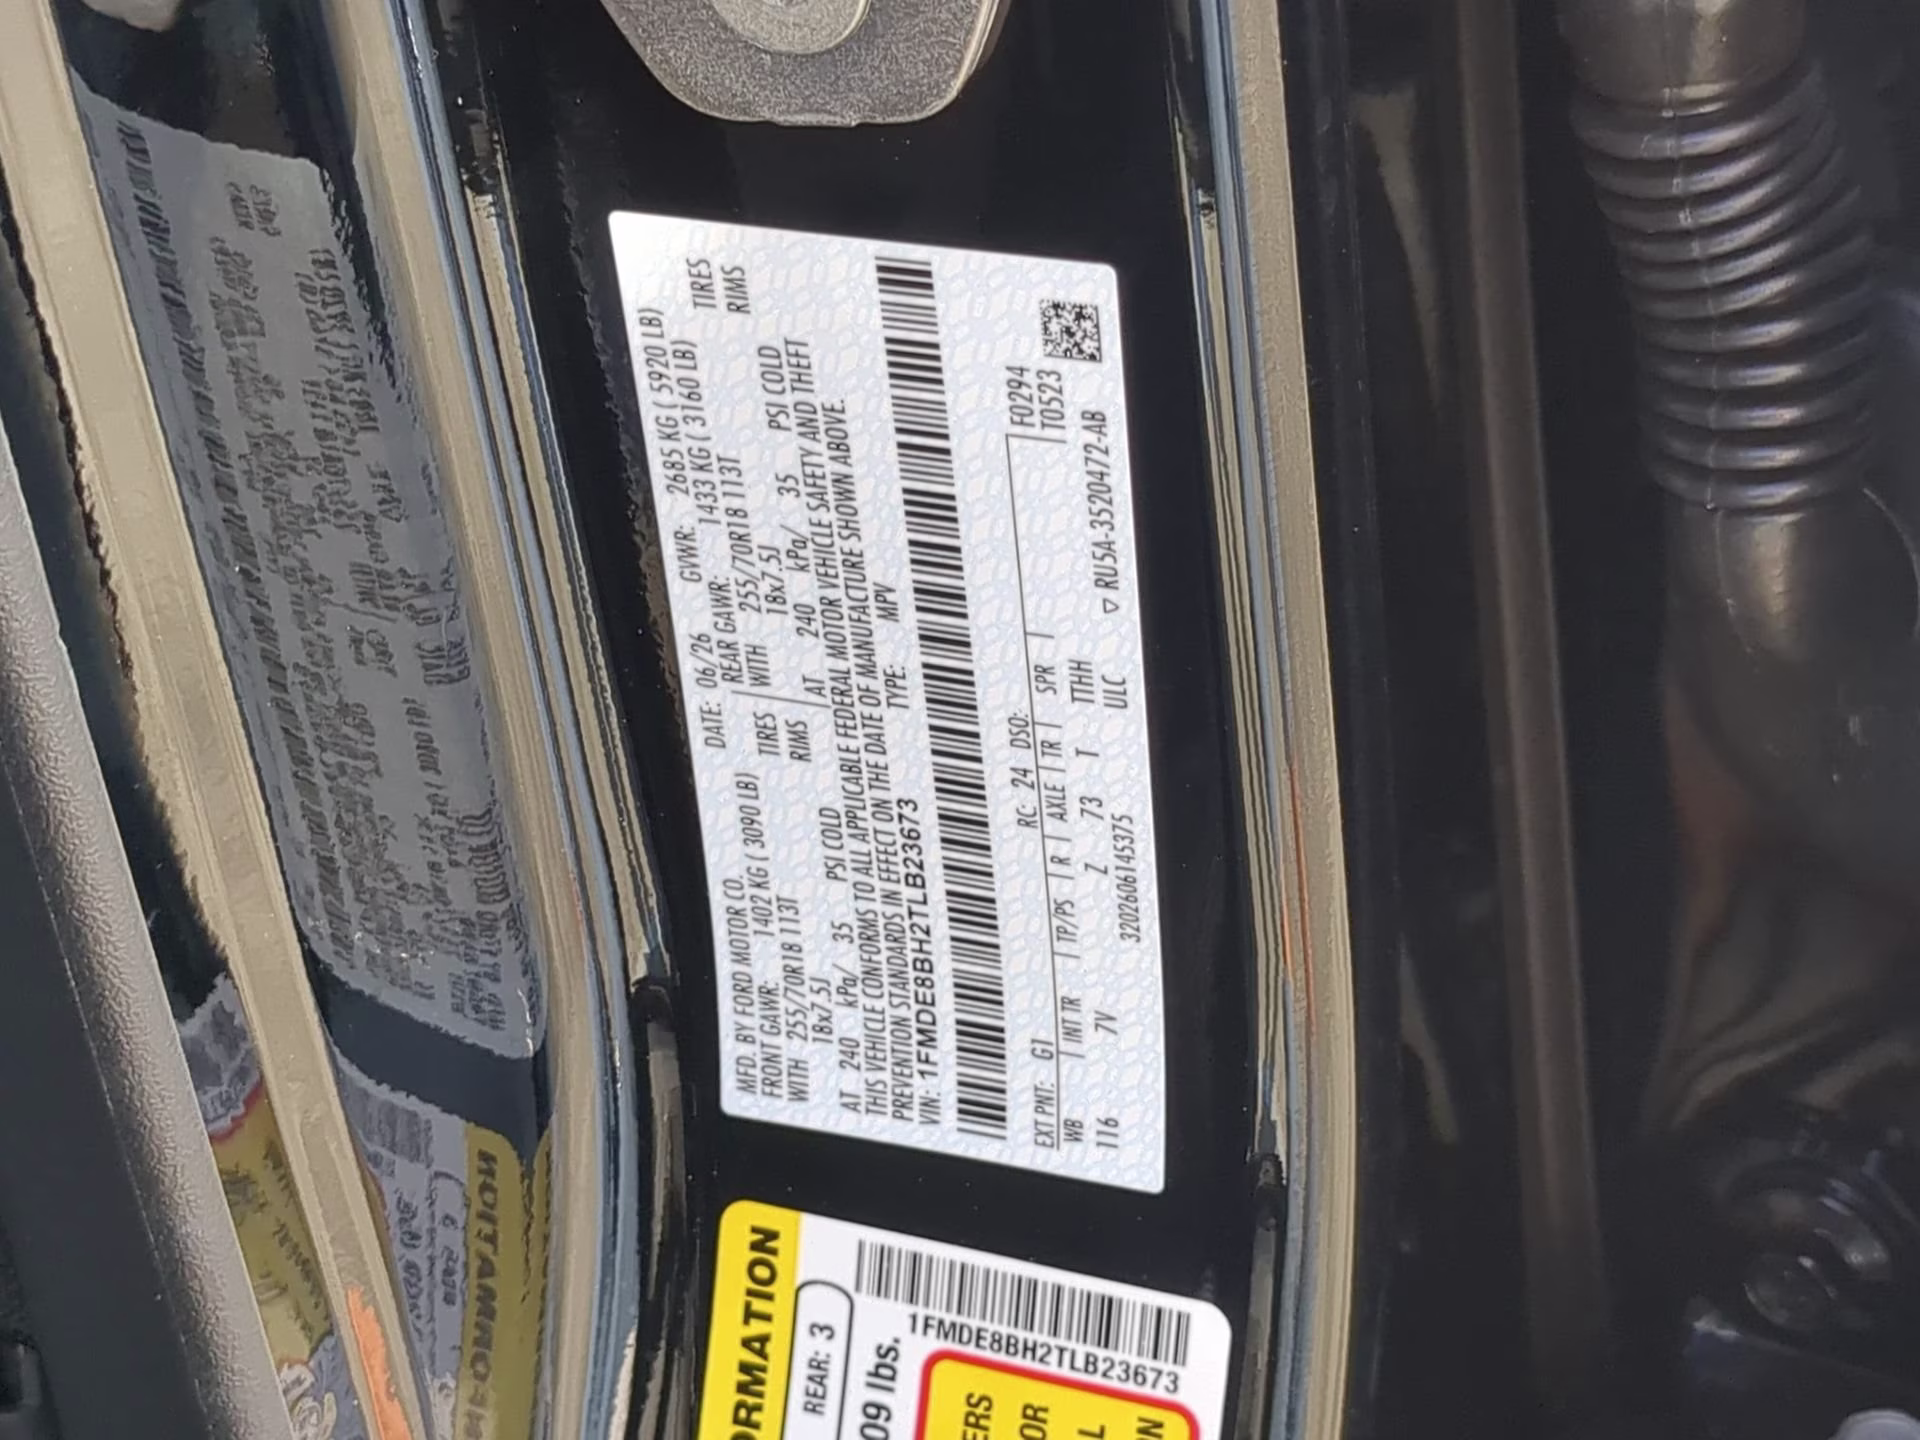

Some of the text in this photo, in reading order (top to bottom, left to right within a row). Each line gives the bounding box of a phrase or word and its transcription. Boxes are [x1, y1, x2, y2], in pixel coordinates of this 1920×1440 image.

[685, 257, 717, 310] TIRES
[720, 265, 751, 315] RIMS
[637, 307, 665, 339] LB)
[670, 339, 698, 371] LB)
[1004, 365, 1036, 428] F0294
[1035, 369, 1067, 430] T0523
[654, 415, 681, 442] KG
[660, 447, 690, 497] 2685
[687, 446, 714, 473] KG
[692, 479, 721, 525] 1433
[756, 345, 827, 698] AT 240 kPa/ 35 PSI COLD
[1080, 409, 1120, 591] RU5A-3520472-AB
[673, 525, 703, 583] GVWR:
[716, 454, 772, 687] WITH 255/70R18 113T
[707, 575, 737, 634] GAWR:
[757, 544, 789, 616] 18x7.5J
[716, 639, 744, 684] REAR
[872, 581, 910, 710] TYPE: MPV
[688, 633, 727, 750] DATE: 06/26
[1033, 664, 1058, 696] SPR
[1067, 658, 1096, 704] TTHH
[1100, 674, 1129, 710] ULC
[752, 711, 781, 757] TIRES
[783, 336, 888, 1116] THIS VEHICLE CONFORMS TO ALL APPLICABLE FEDERAL MOTOR VEHICLE SAFETY AND THEFT
[784, 719, 812, 763] RIMS
[1040, 739, 1063, 758] TR
[821, 399, 914, 1122] PREVENTION STANDARDS IN EFFECT ON THE DATE OF MANUFACTURE SHOWN ABOVE.
[1074, 746, 1100, 758] T
[733, 772, 760, 801] LB)
[1009, 766, 1036, 791] 24
[1043, 782, 1068, 823] AXLE
[1078, 795, 1105, 821] 73
[745, 865, 770, 890] KG
[1049, 854, 1072, 867] R
[1083, 861, 1109, 876] Z
[1110, 813, 1142, 944] 3202606145375
[749, 894, 775, 937] 1402
[1052, 898, 1079, 943] TP/PS
[721, 875, 757, 1095] MFD. BY FORD MOTOR CO.
[818, 806, 861, 1114] AT 240 kPa/ 35 PSI COLD
[895, 797, 941, 1125] VIN: 1FMDE8BH2TLB23673
[757, 980, 782, 1037] GAWR:
[775, 894, 810, 1102] WITH 255/70R18 113T
[809, 976, 834, 1044] 18x7.5J
[1060, 995, 1083, 1044] INT TR
[1094, 1009, 1119, 1036] 7V
[760, 1041, 783, 1099] FRONT
[1030, 1038, 1055, 1149] EXT PNT: G1
[1063, 1118, 1084, 1143] WB
[1095, 1117, 1120, 1150] 116
[802, 1321, 836, 1416] REAR: 3
[864, 1336, 901, 1393] lbs.
[908, 1312, 1181, 1394] 1FMDE8BH2TLB23673
